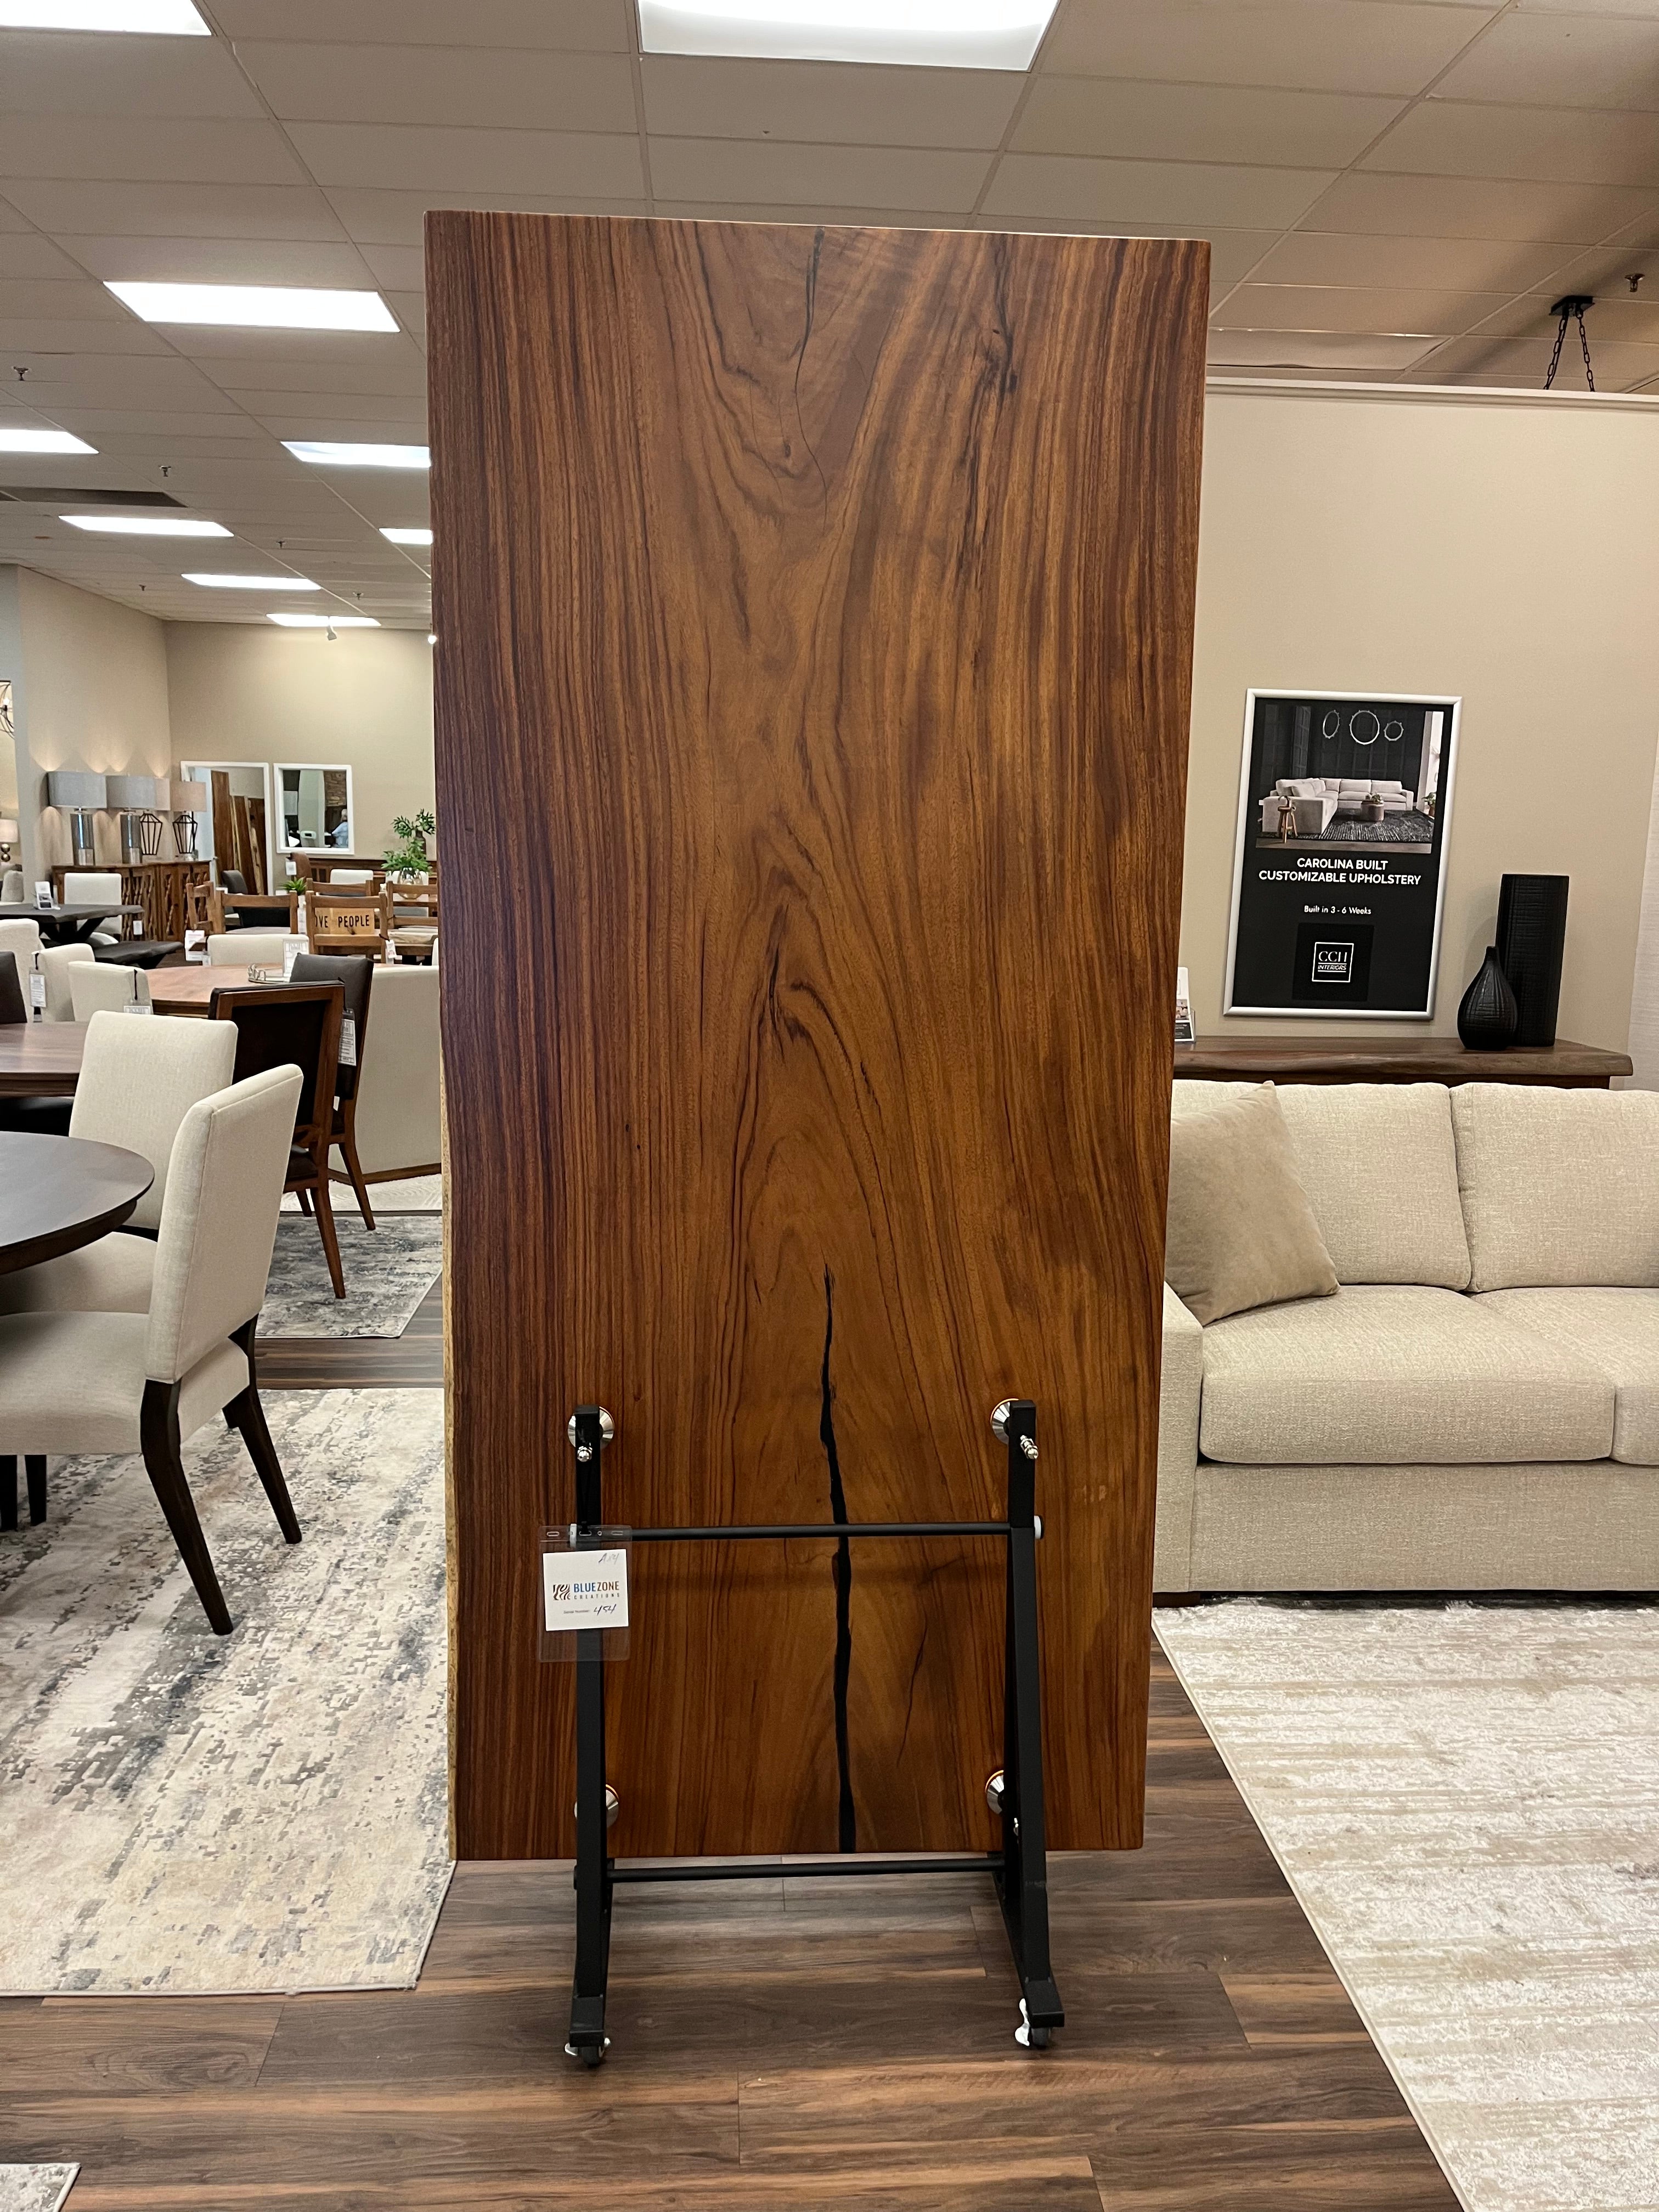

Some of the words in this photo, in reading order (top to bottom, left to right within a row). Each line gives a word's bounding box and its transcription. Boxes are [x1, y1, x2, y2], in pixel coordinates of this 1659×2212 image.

[1297, 857, 1353, 869] CAROLINA
[1356, 860, 1388, 870] BUILT
[1259, 870, 1346, 883] CUSTOMIZABLE
[1348, 873, 1421, 885] UPHOLSTERY
[338, 915, 370, 928] PEOPLE
[1318, 951, 1347, 962] CCH
[574, 1581, 619, 1593] BLUEZONE
[593, 1604, 617, 1616] 454
